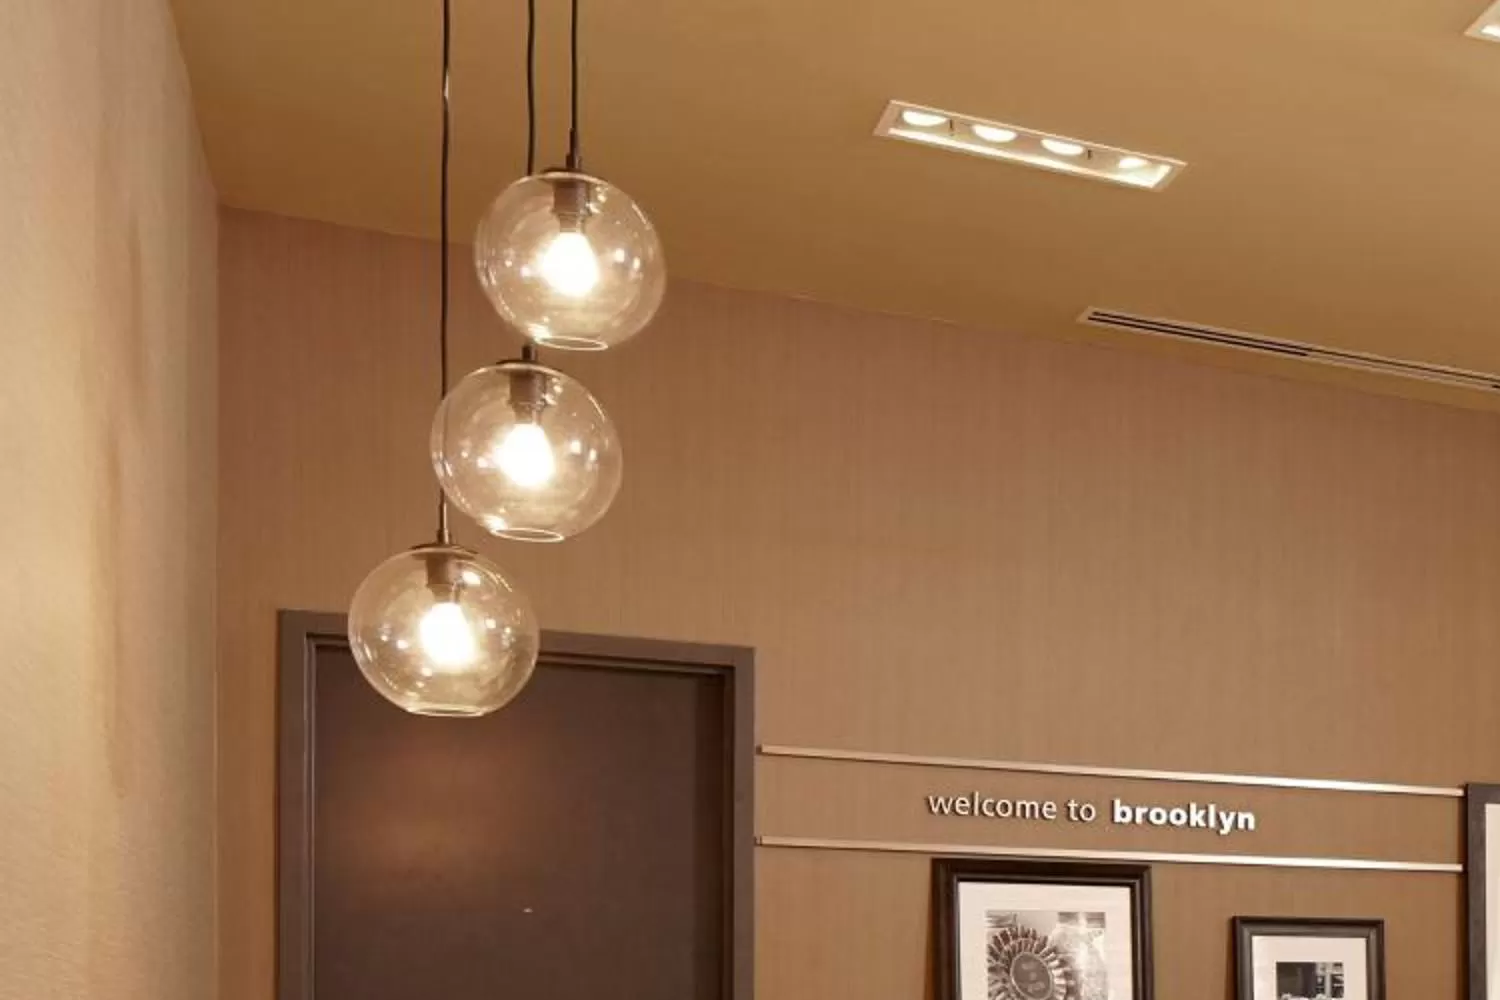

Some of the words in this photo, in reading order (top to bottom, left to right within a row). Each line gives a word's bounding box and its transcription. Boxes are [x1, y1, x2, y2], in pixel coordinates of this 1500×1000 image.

[927, 791, 1057, 820] welcome
[1067, 799, 1097, 822] to
[1112, 798, 1257, 835] brooklyn
